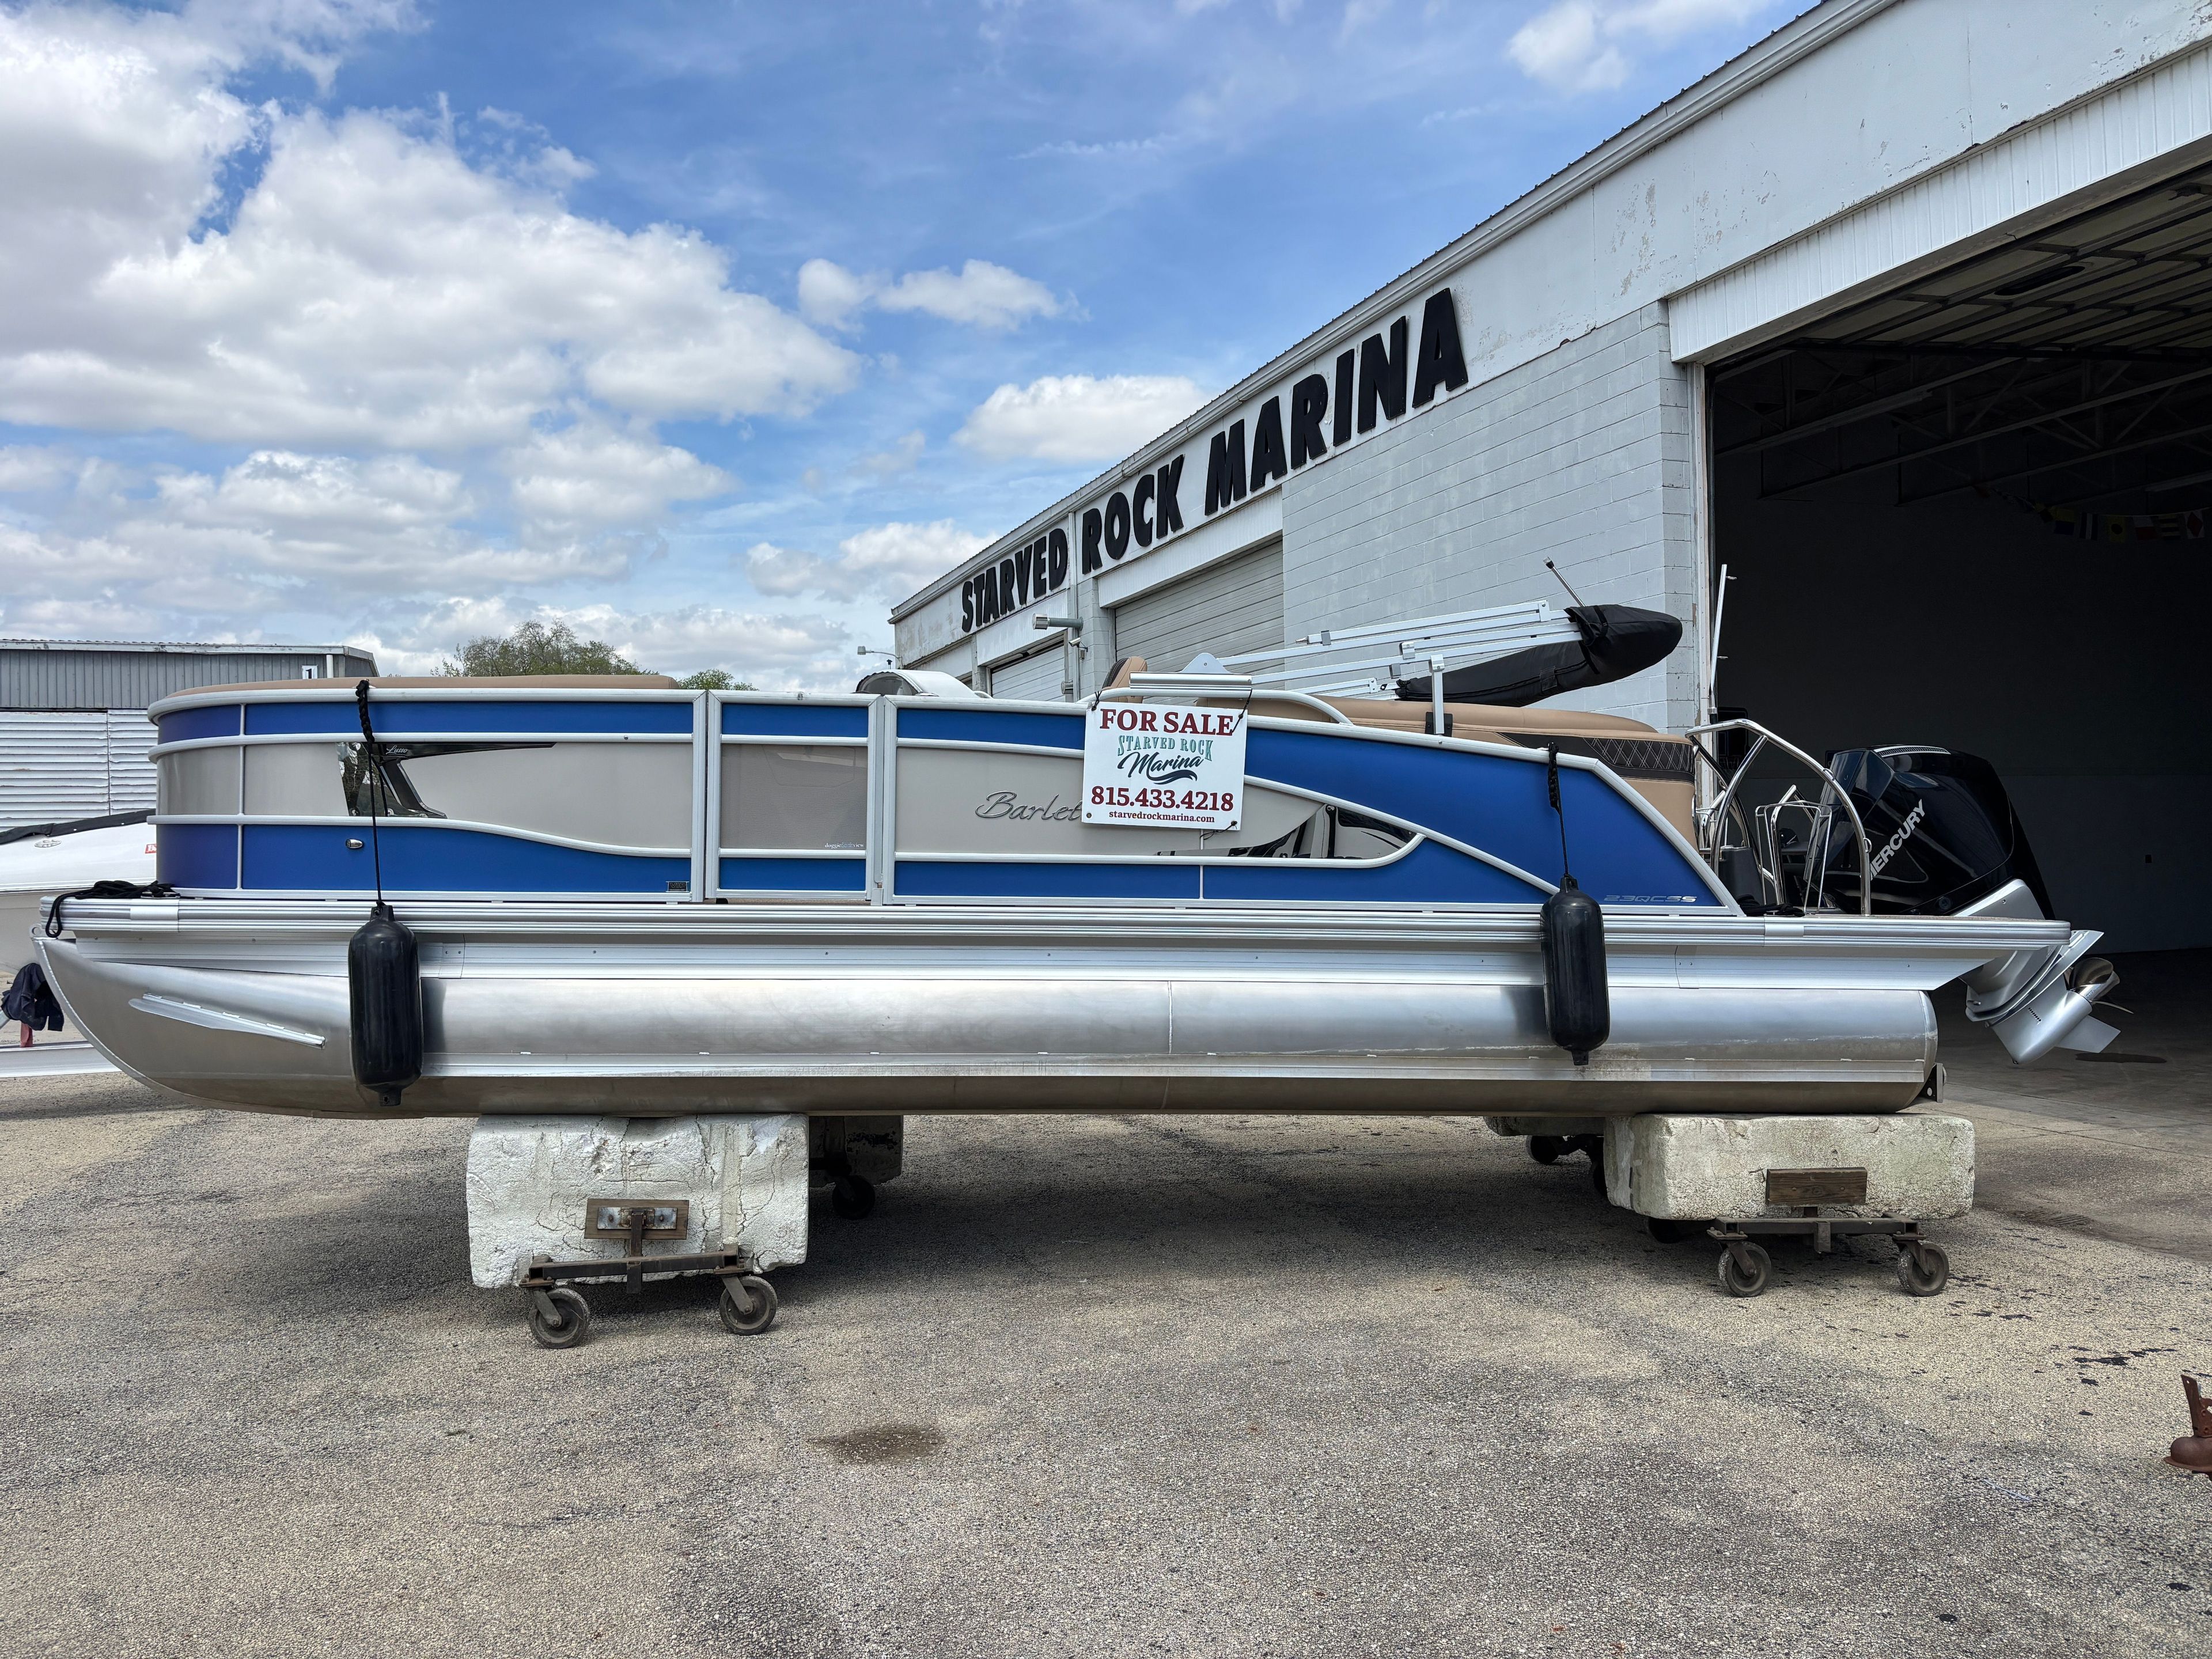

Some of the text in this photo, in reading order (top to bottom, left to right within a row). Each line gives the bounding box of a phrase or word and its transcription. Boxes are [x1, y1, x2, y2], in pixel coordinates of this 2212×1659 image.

[961, 287, 1468, 632] STARVED ROCK MARINA
[305, 668, 312, 679] 1
[1100, 708, 1233, 736] FOR SALE
[385, 745, 408, 755] Lusso
[1118, 735, 1214, 762] STARVED ROCK
[1117, 751, 1204, 783] Marina
[1091, 786, 1234, 812] 815.433.4218
[1109, 810, 1215, 823] starvedrockmarina.com
[1604, 895, 1697, 903] 23QCSS
